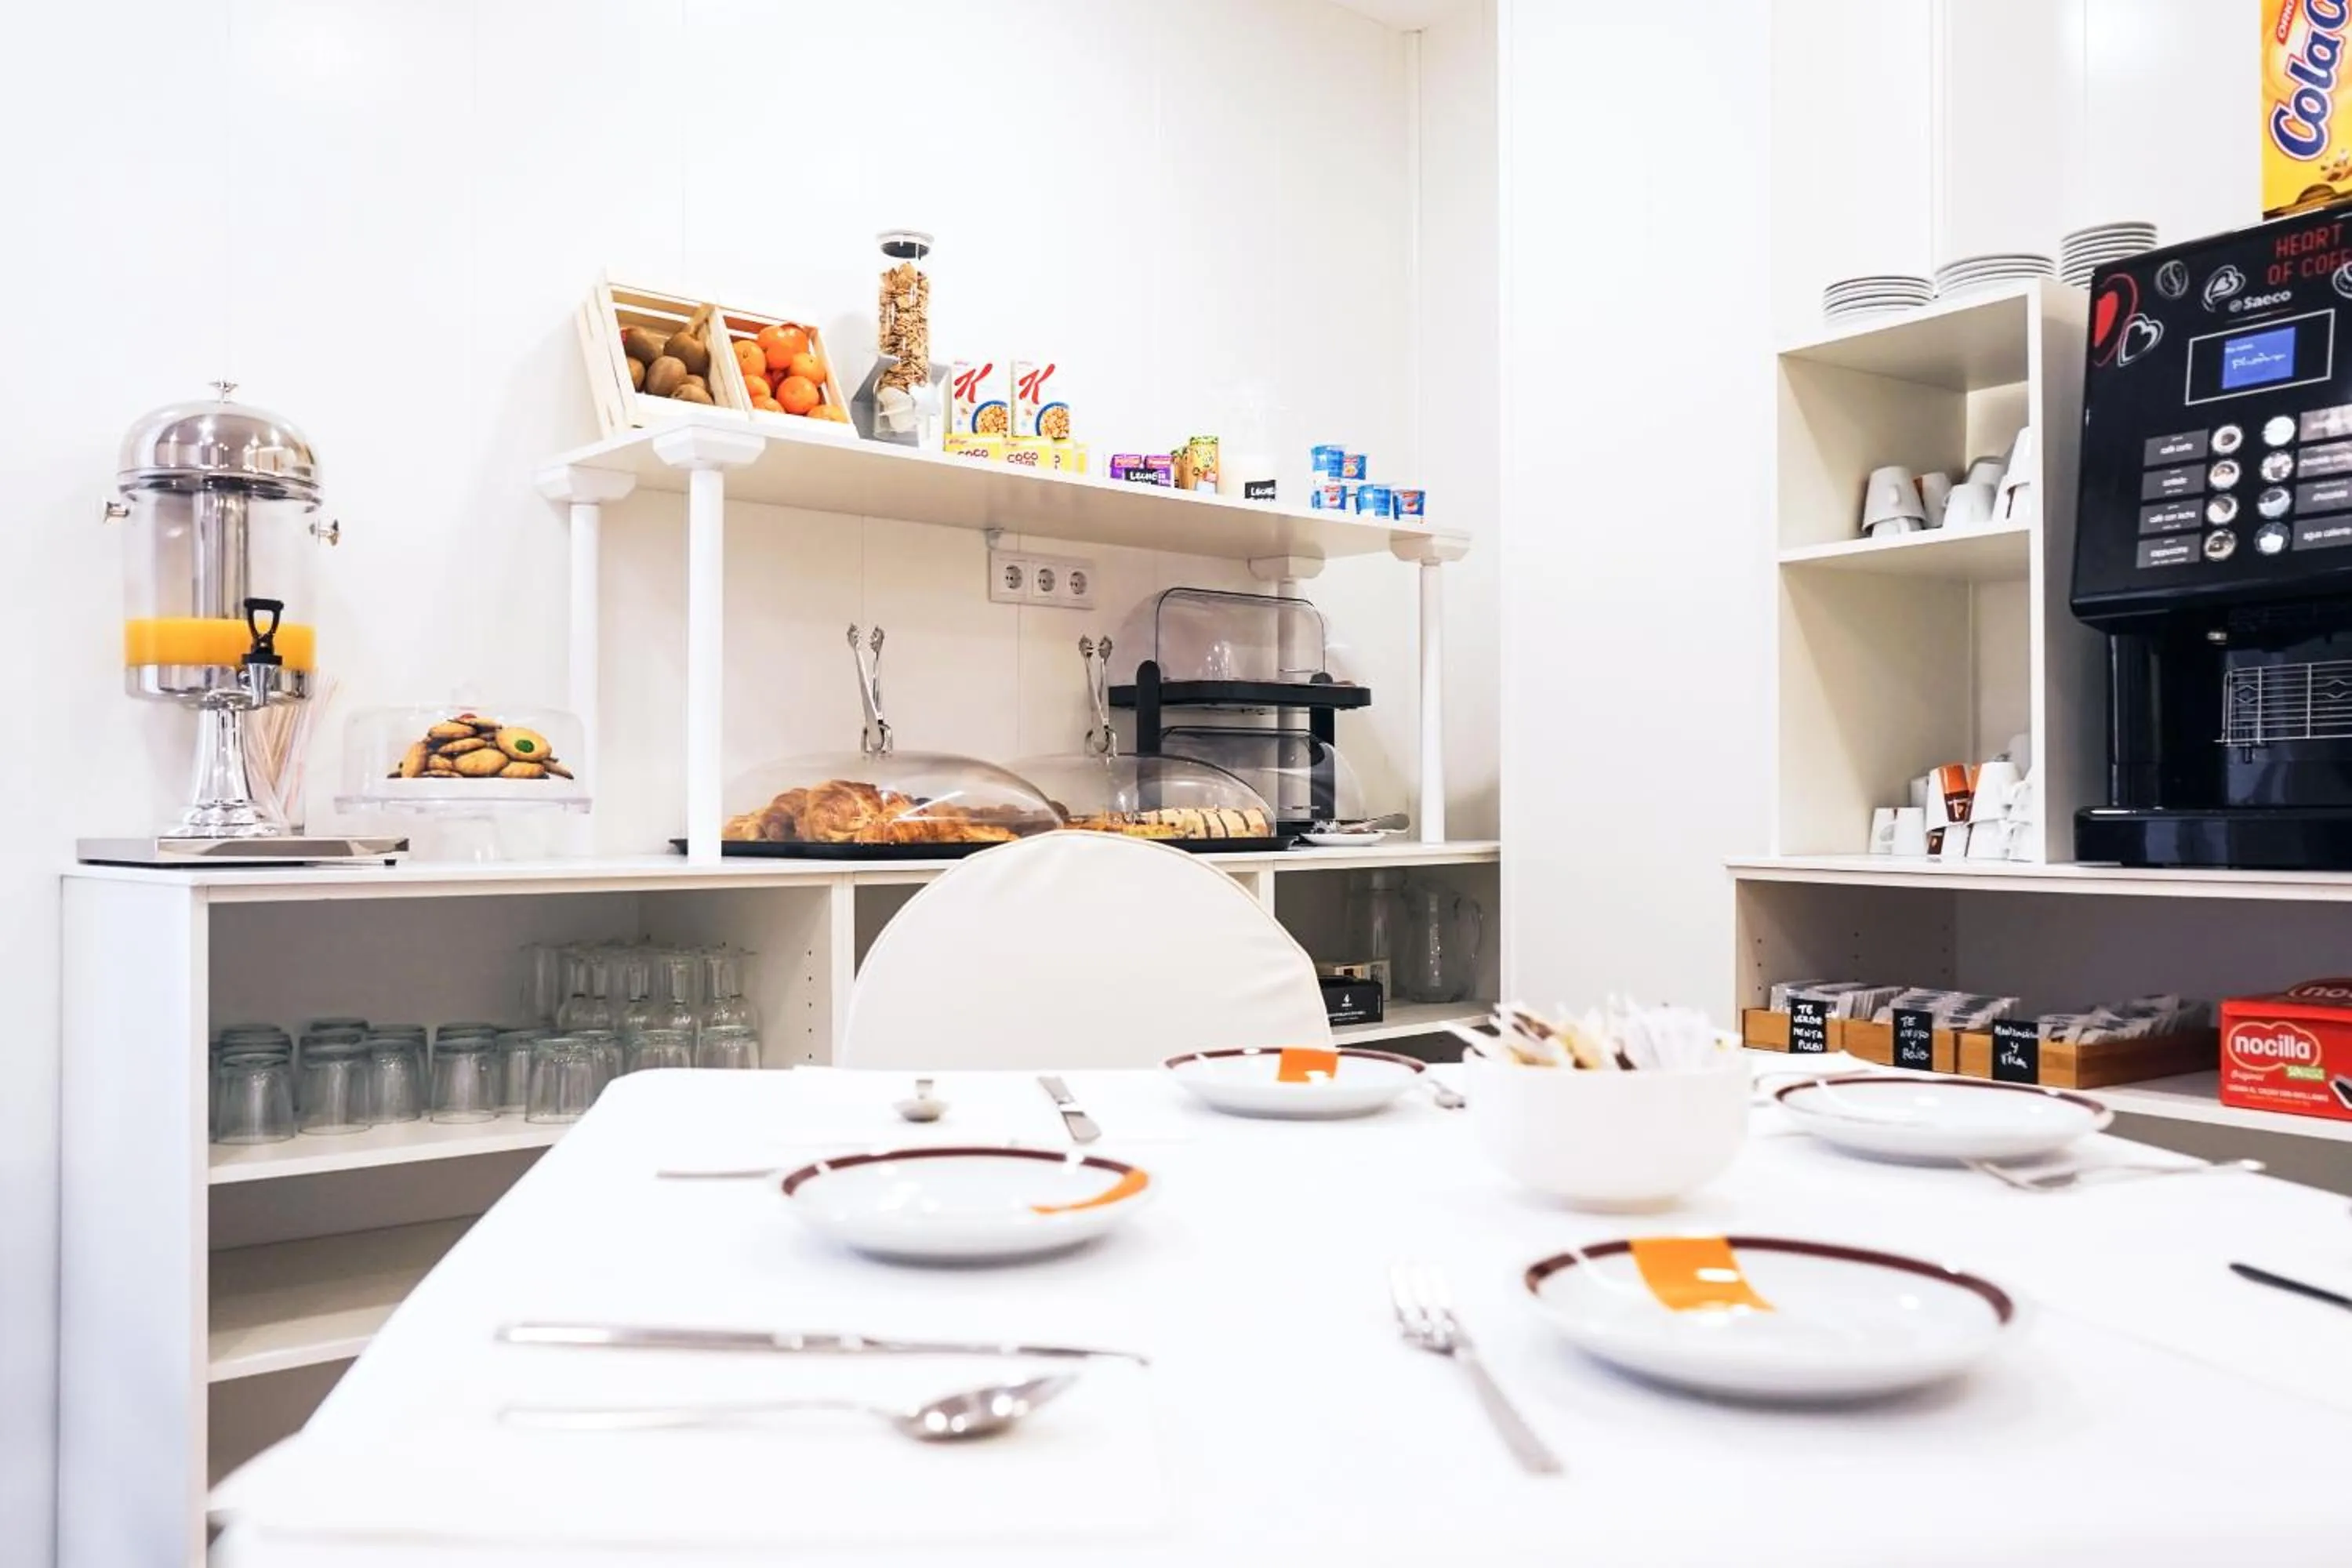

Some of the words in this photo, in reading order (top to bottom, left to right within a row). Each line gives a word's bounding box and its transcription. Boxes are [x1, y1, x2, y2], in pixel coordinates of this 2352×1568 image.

[2275, 223, 2343, 258] HEART
[2267, 261, 2293, 285] OF
[2243, 290, 2292, 310] Saeco
[2234, 1033, 2311, 1059] nocilla
